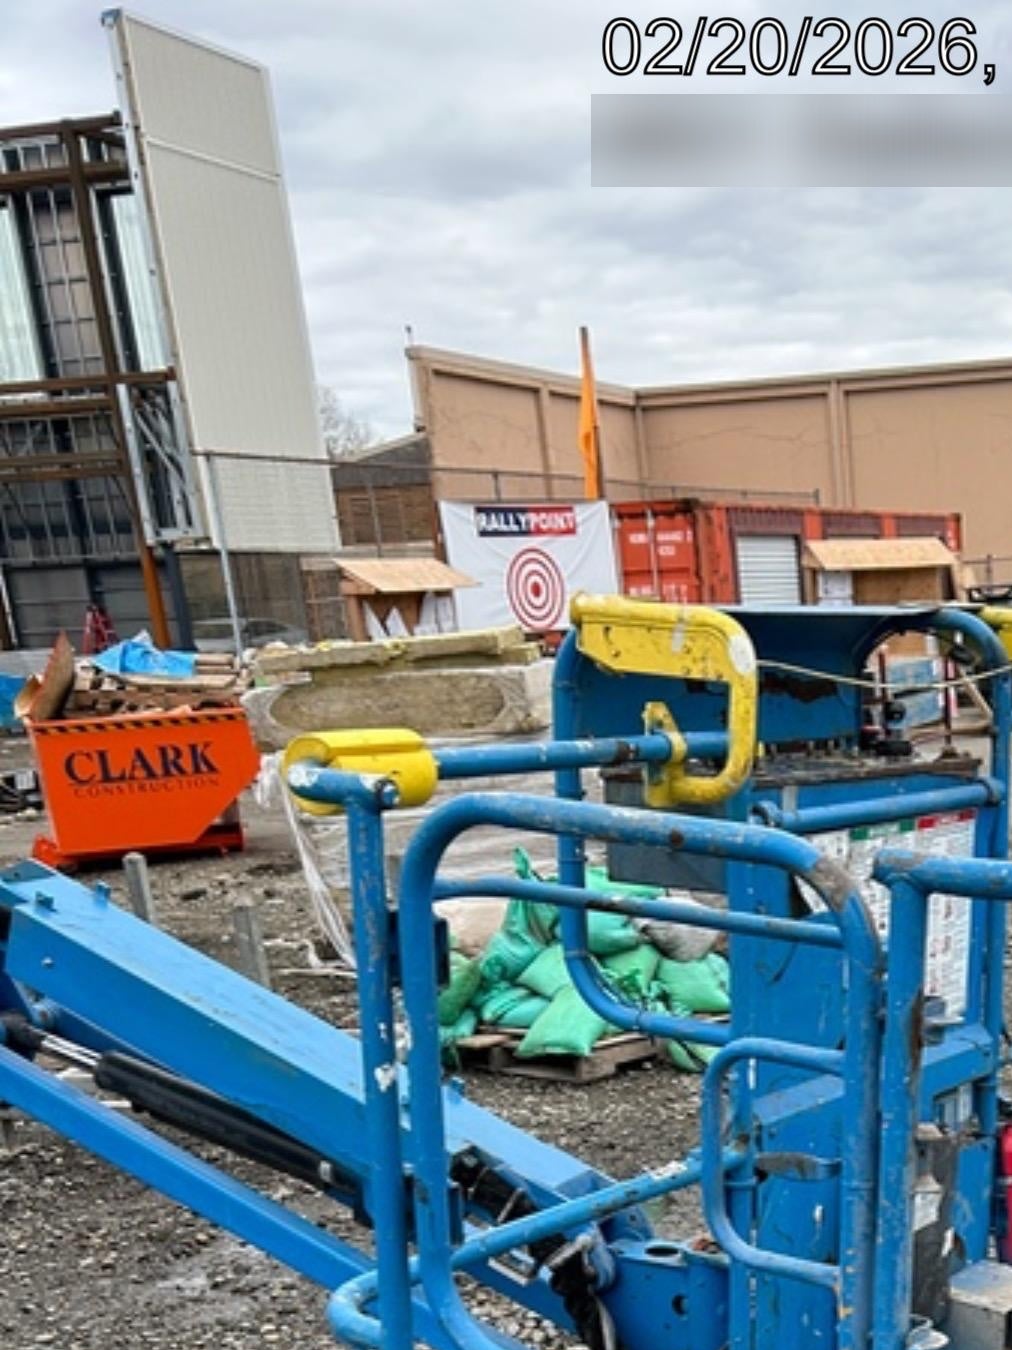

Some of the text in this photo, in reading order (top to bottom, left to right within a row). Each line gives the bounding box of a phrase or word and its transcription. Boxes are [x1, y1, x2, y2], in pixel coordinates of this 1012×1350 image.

[477, 511, 574, 532] RALLYPOINT
[64, 742, 217, 784] CLARK
[74, 777, 218, 798] CONSTRUCTION
